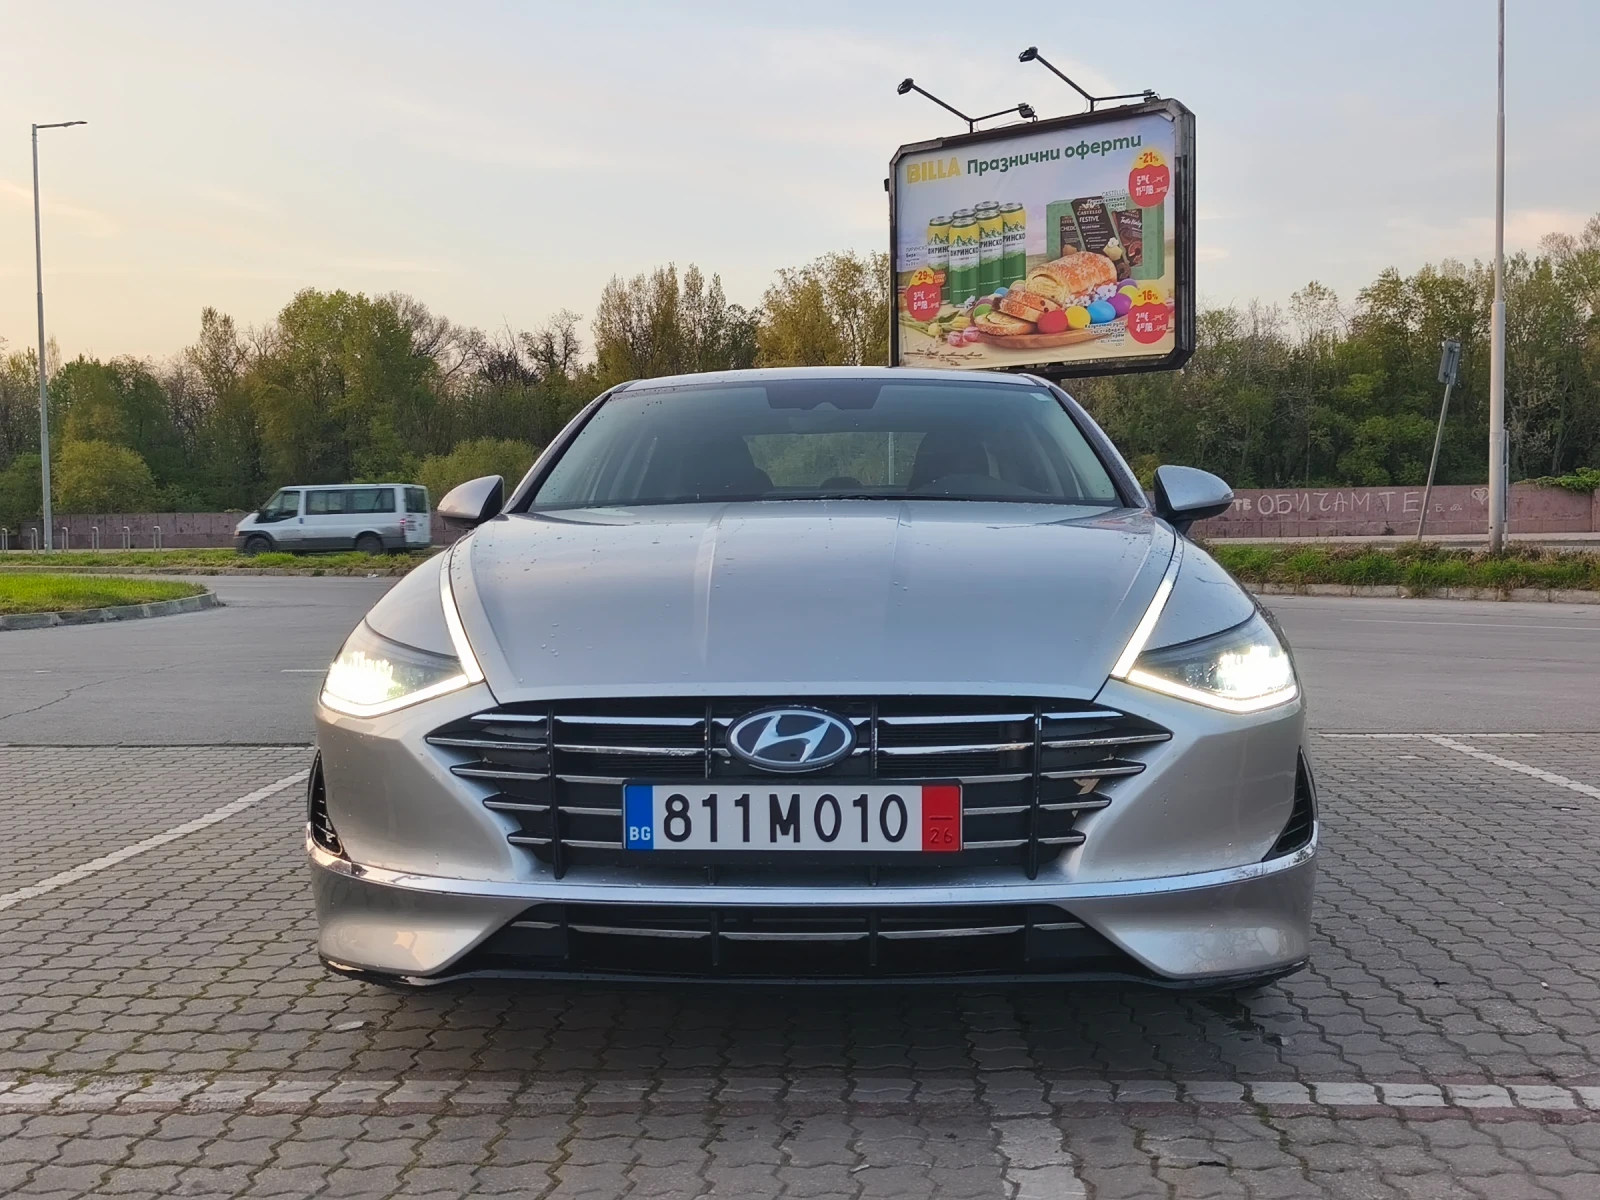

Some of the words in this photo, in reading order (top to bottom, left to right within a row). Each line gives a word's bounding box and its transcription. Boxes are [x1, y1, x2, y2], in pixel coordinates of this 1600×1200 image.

[967, 149, 1060, 176] Празнични
[1065, 135, 1141, 159] оферти
[907, 157, 961, 184] BILLA
[1138, 290, 1158, 300] -16%
[663, 793, 908, 843] 811M010
[629, 827, 651, 841] BG
[930, 827, 953, 844] 26
